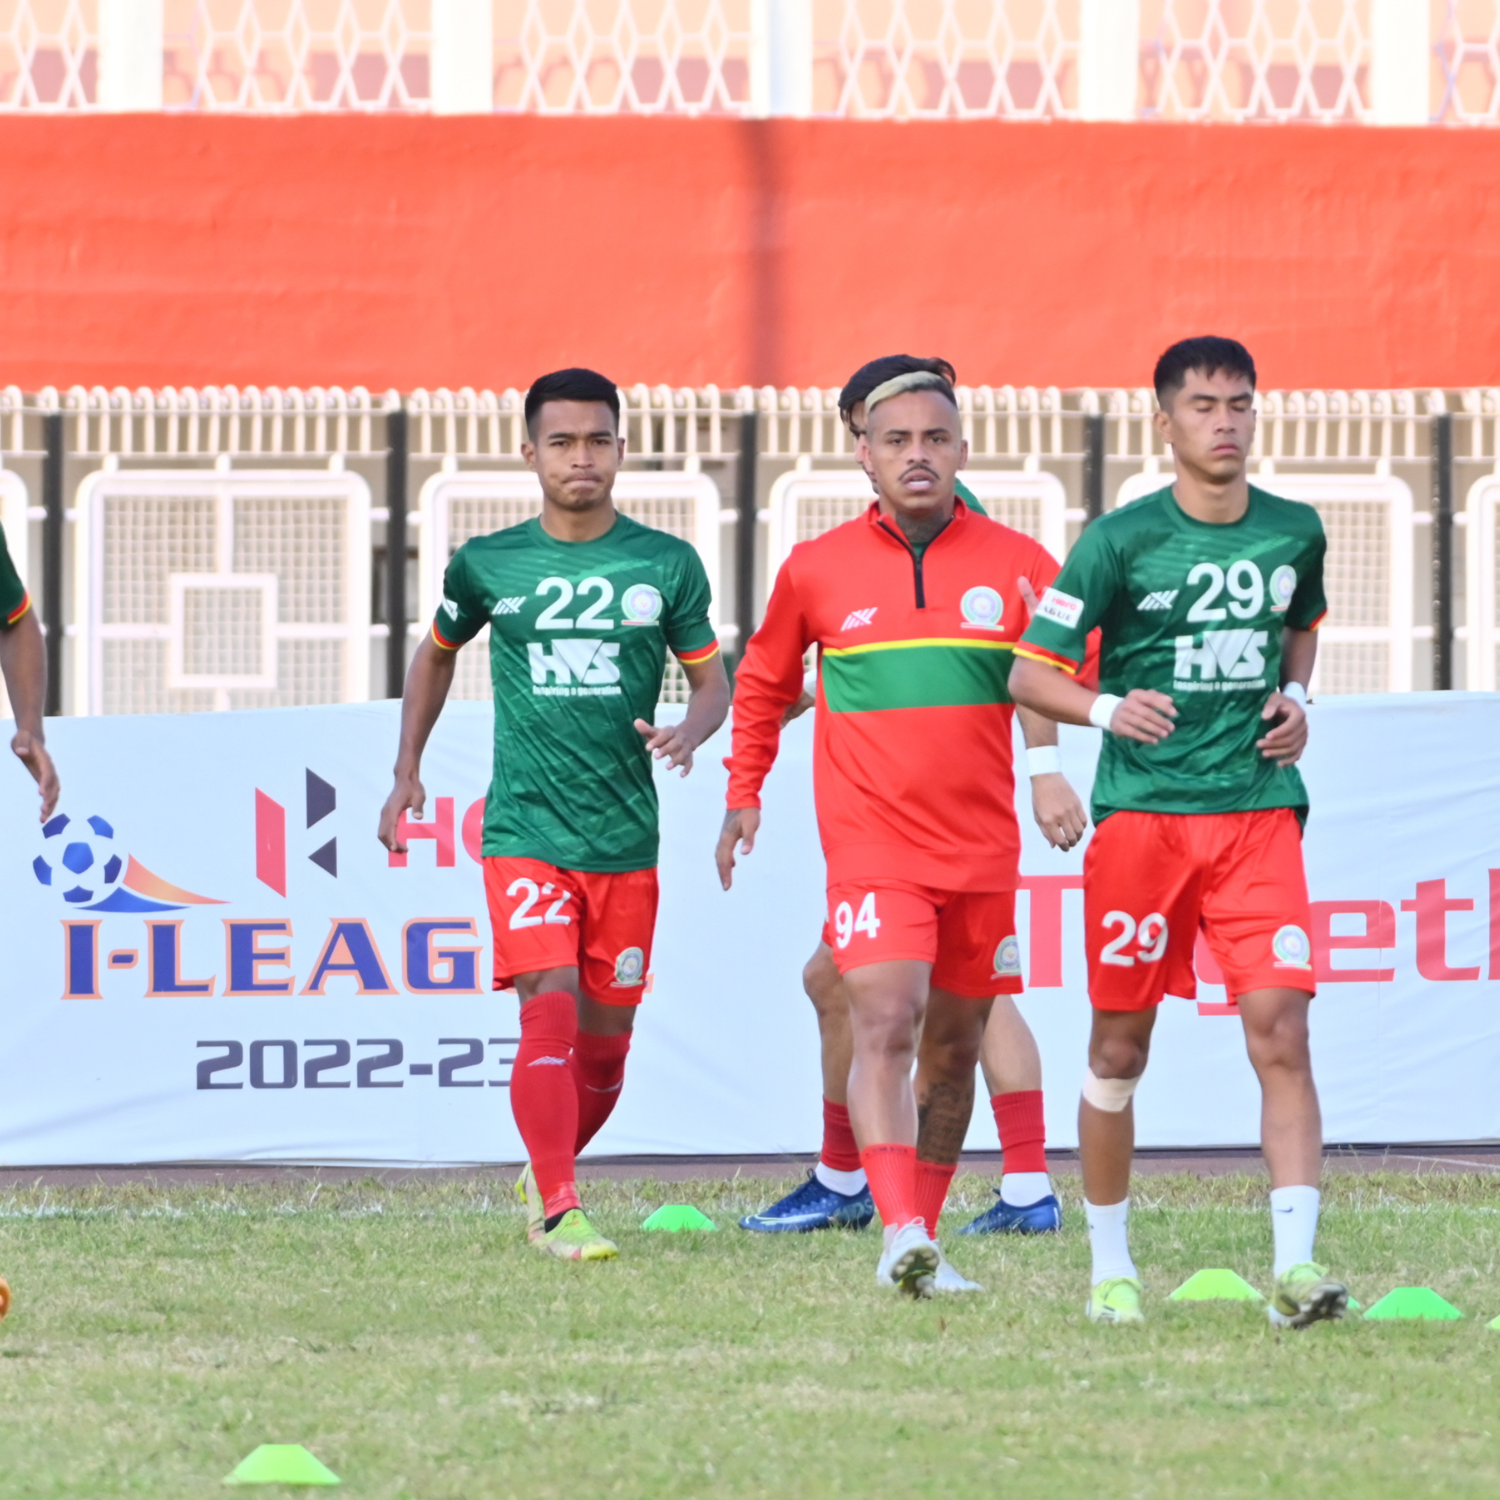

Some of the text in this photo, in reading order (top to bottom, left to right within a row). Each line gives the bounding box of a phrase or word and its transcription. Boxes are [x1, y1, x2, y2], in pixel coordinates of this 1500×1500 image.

[535, 576, 614, 630] 22
[1186, 559, 1265, 623] 29
[506, 877, 572, 931] 22
[835, 892, 881, 949] 94
[1100, 911, 1169, 967] 29
